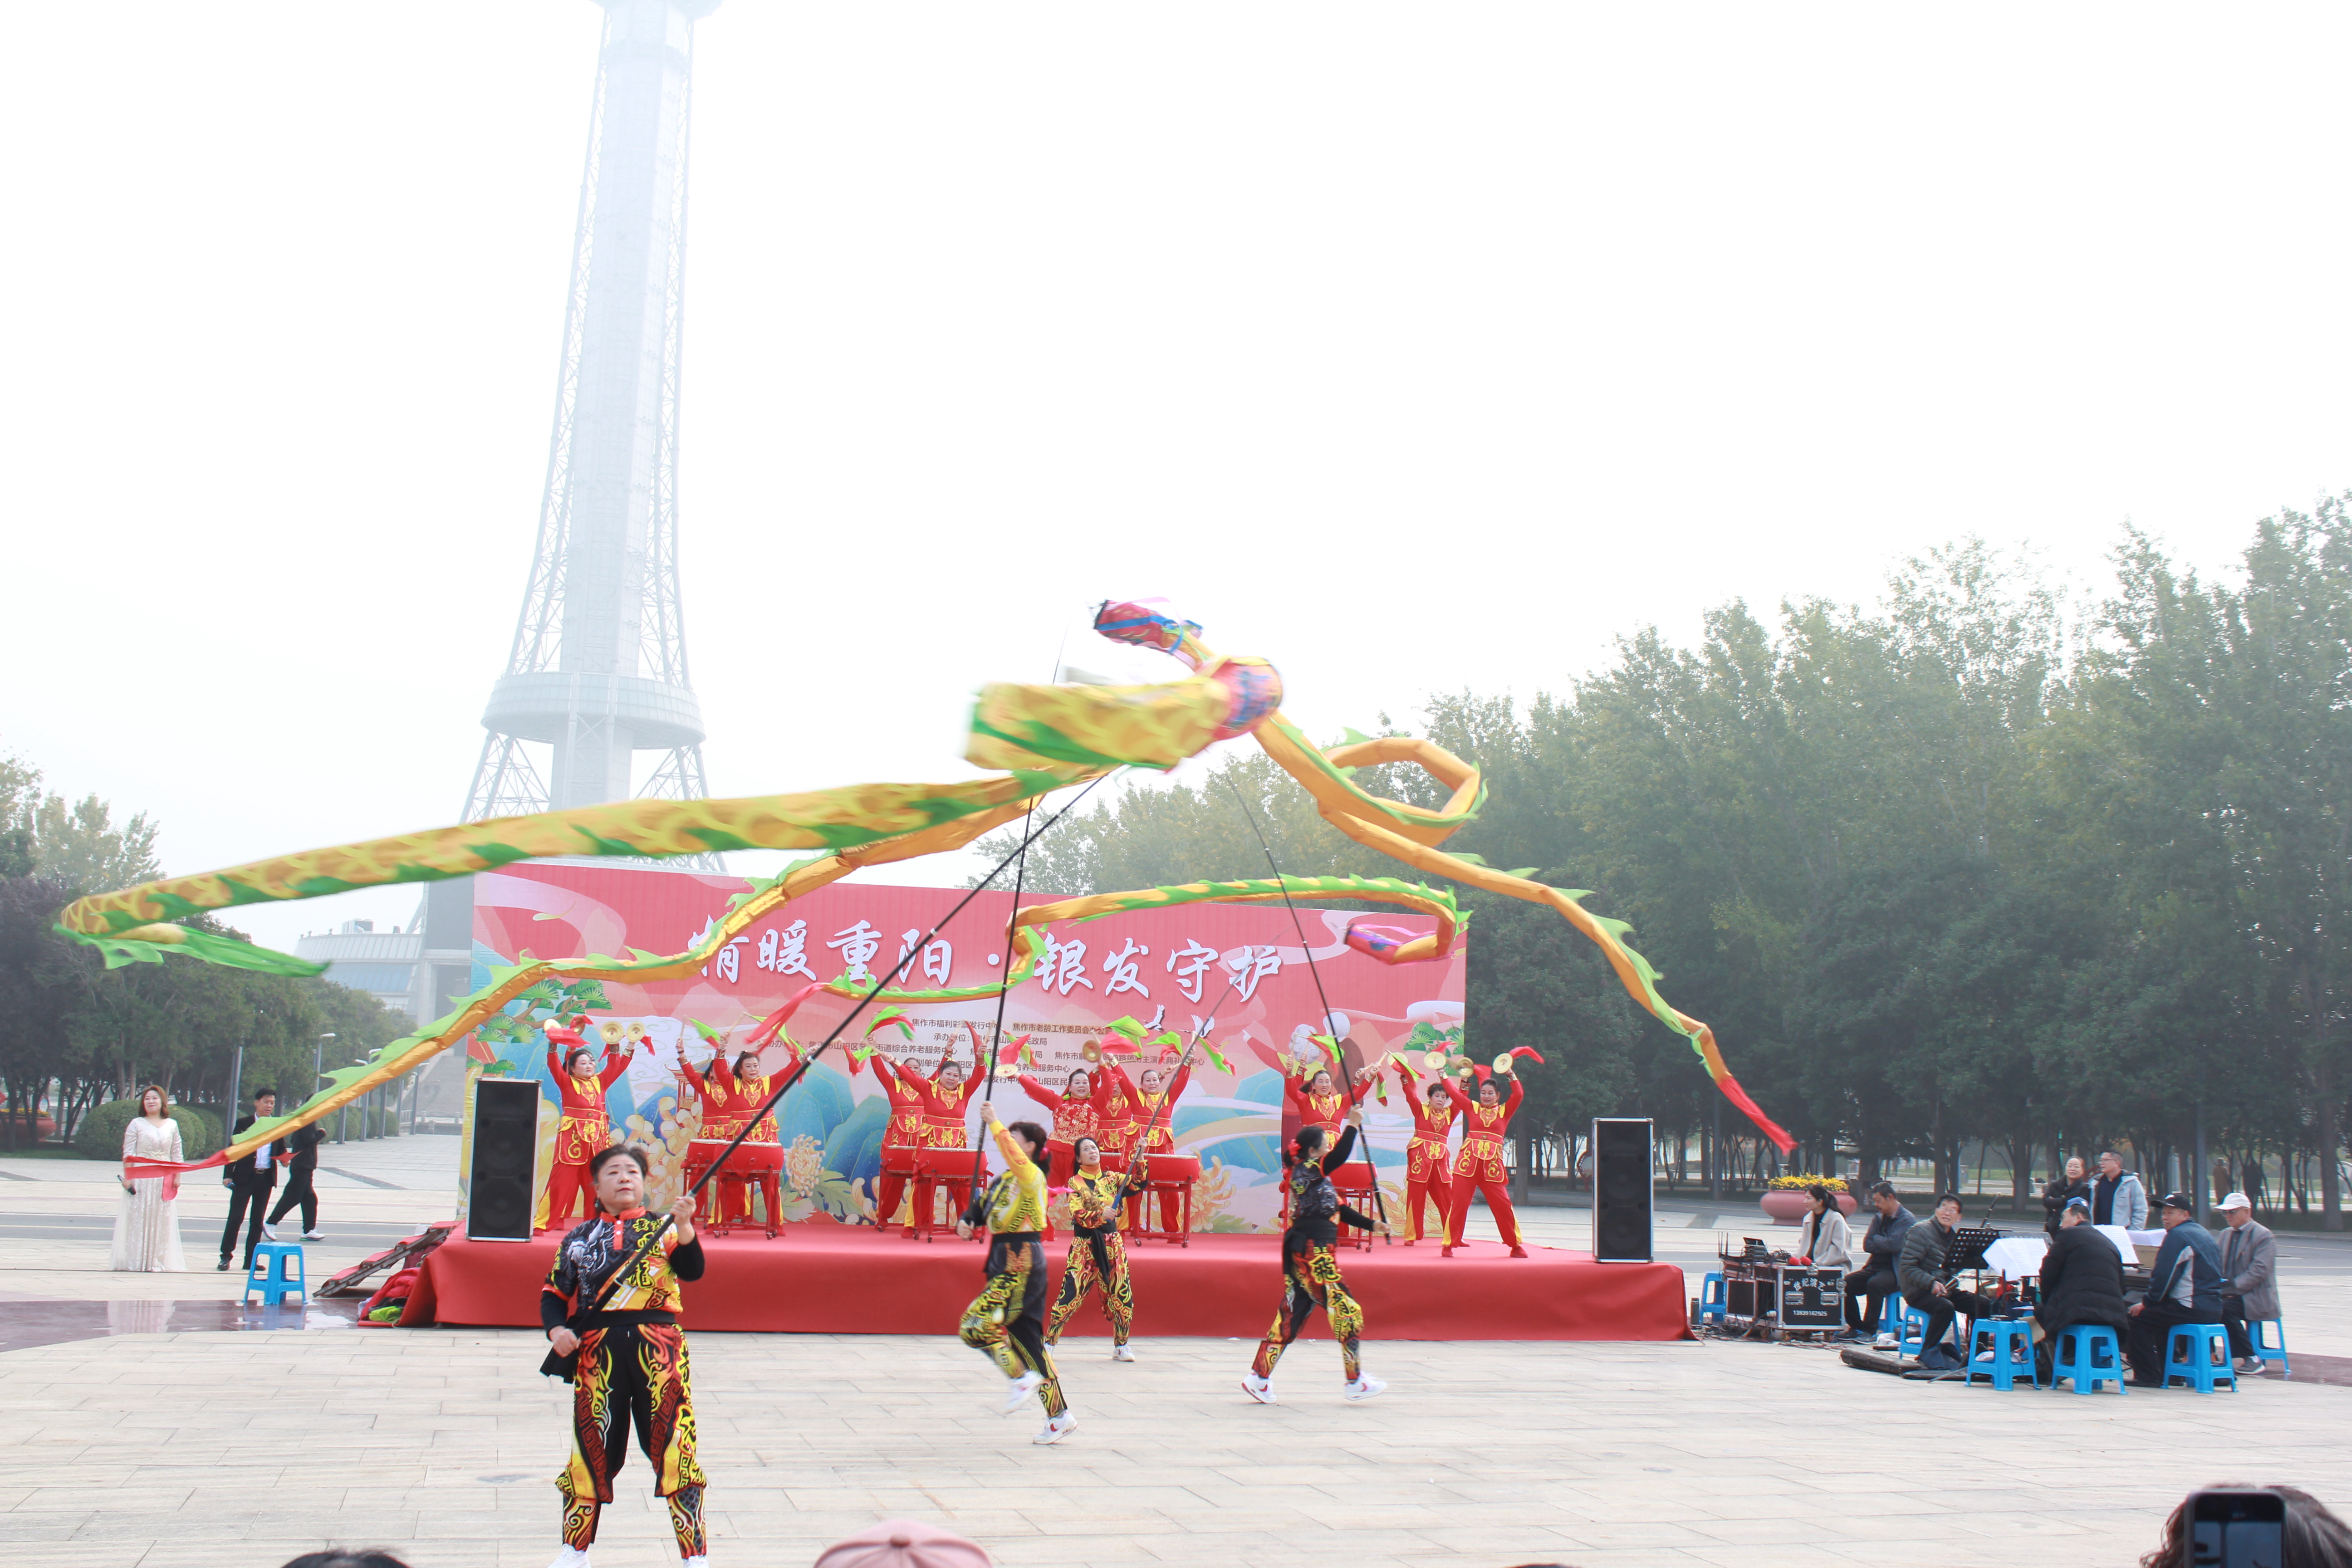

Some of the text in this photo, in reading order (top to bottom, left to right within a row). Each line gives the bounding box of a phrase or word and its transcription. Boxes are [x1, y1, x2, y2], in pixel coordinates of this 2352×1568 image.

[1039, 1077, 1070, 1086] 山阳区民
[1793, 1277, 1826, 1292] 世纪演艺
